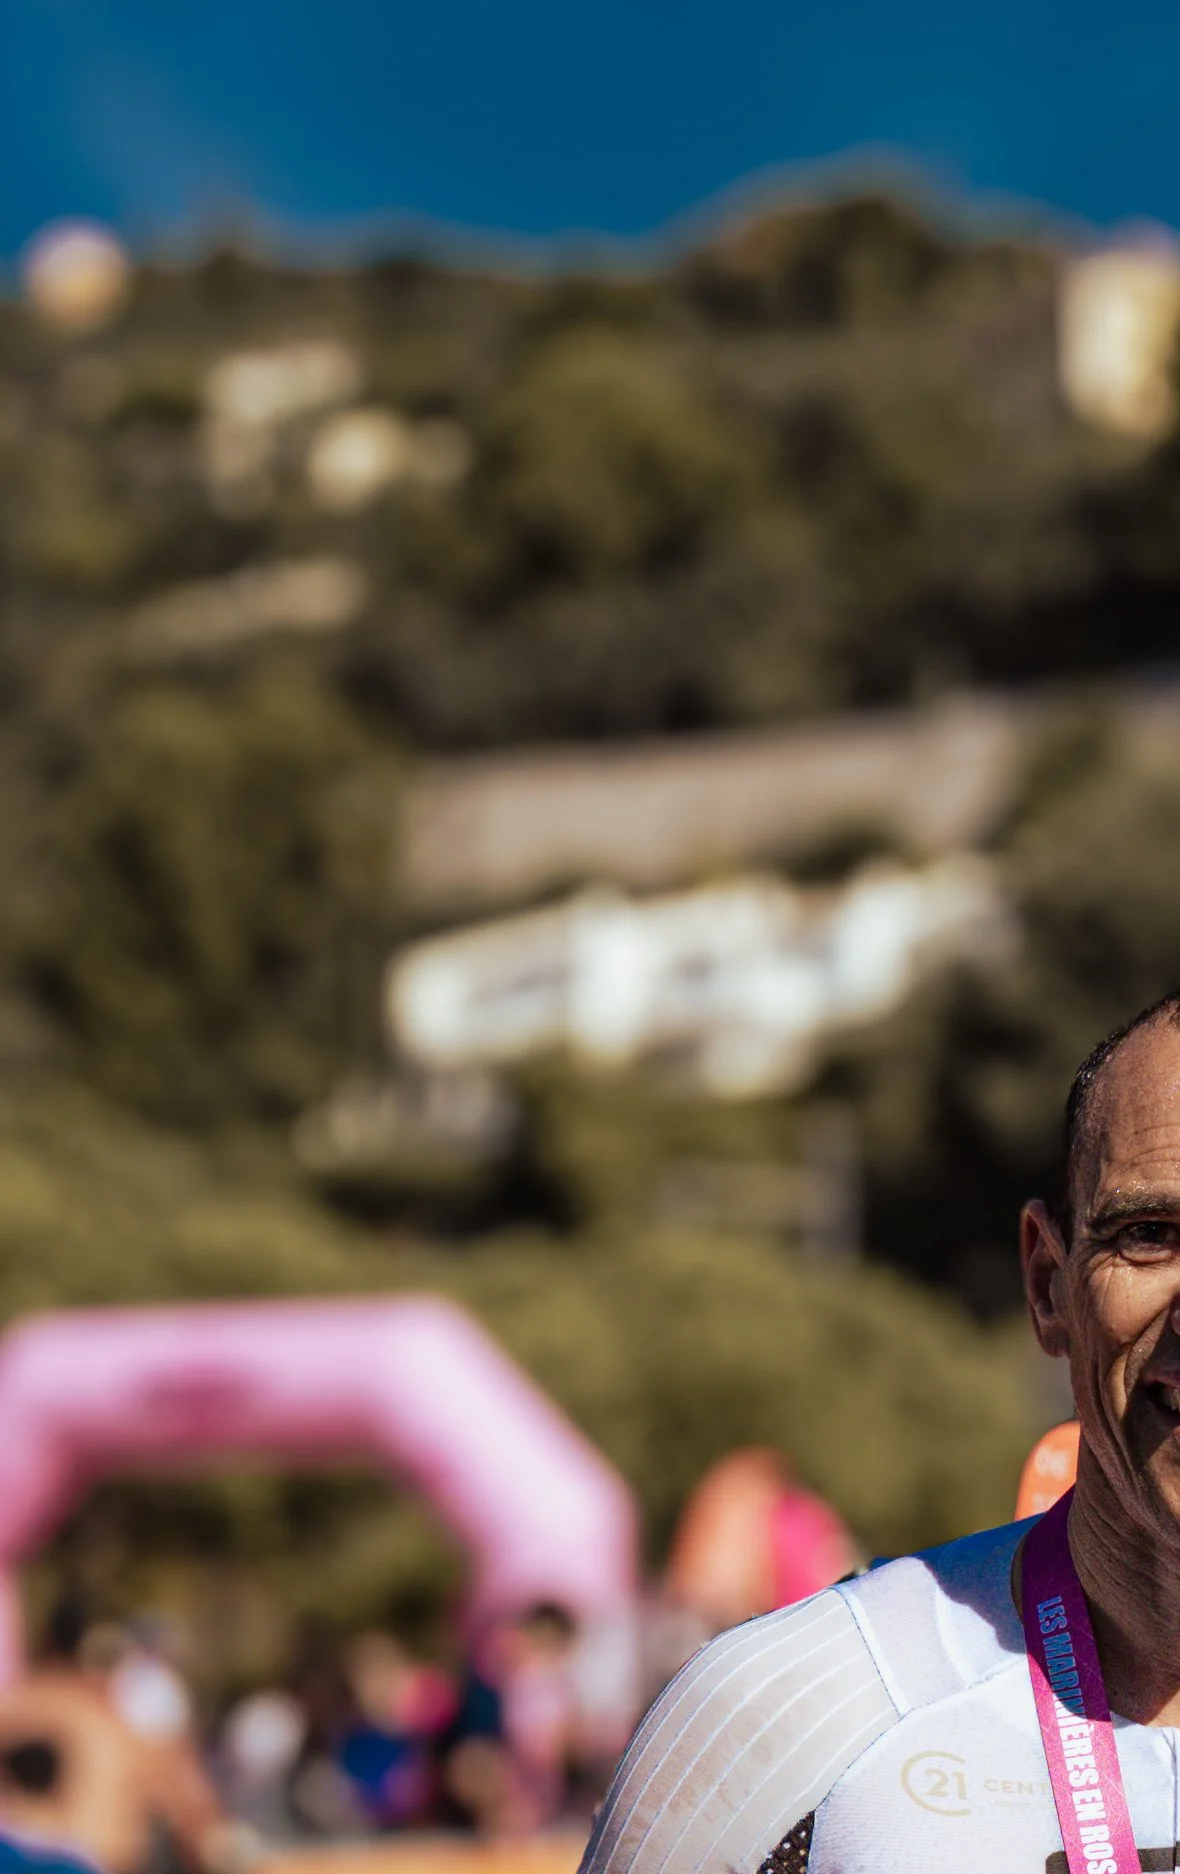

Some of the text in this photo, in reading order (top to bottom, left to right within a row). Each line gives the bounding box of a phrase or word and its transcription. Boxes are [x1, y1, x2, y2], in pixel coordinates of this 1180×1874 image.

[1036, 1594, 1068, 1635] LES
[1042, 1631, 1100, 1788] MARINIÈRES
[984, 1777, 1050, 1796] CENT
[1072, 1788, 1107, 1822] EN
